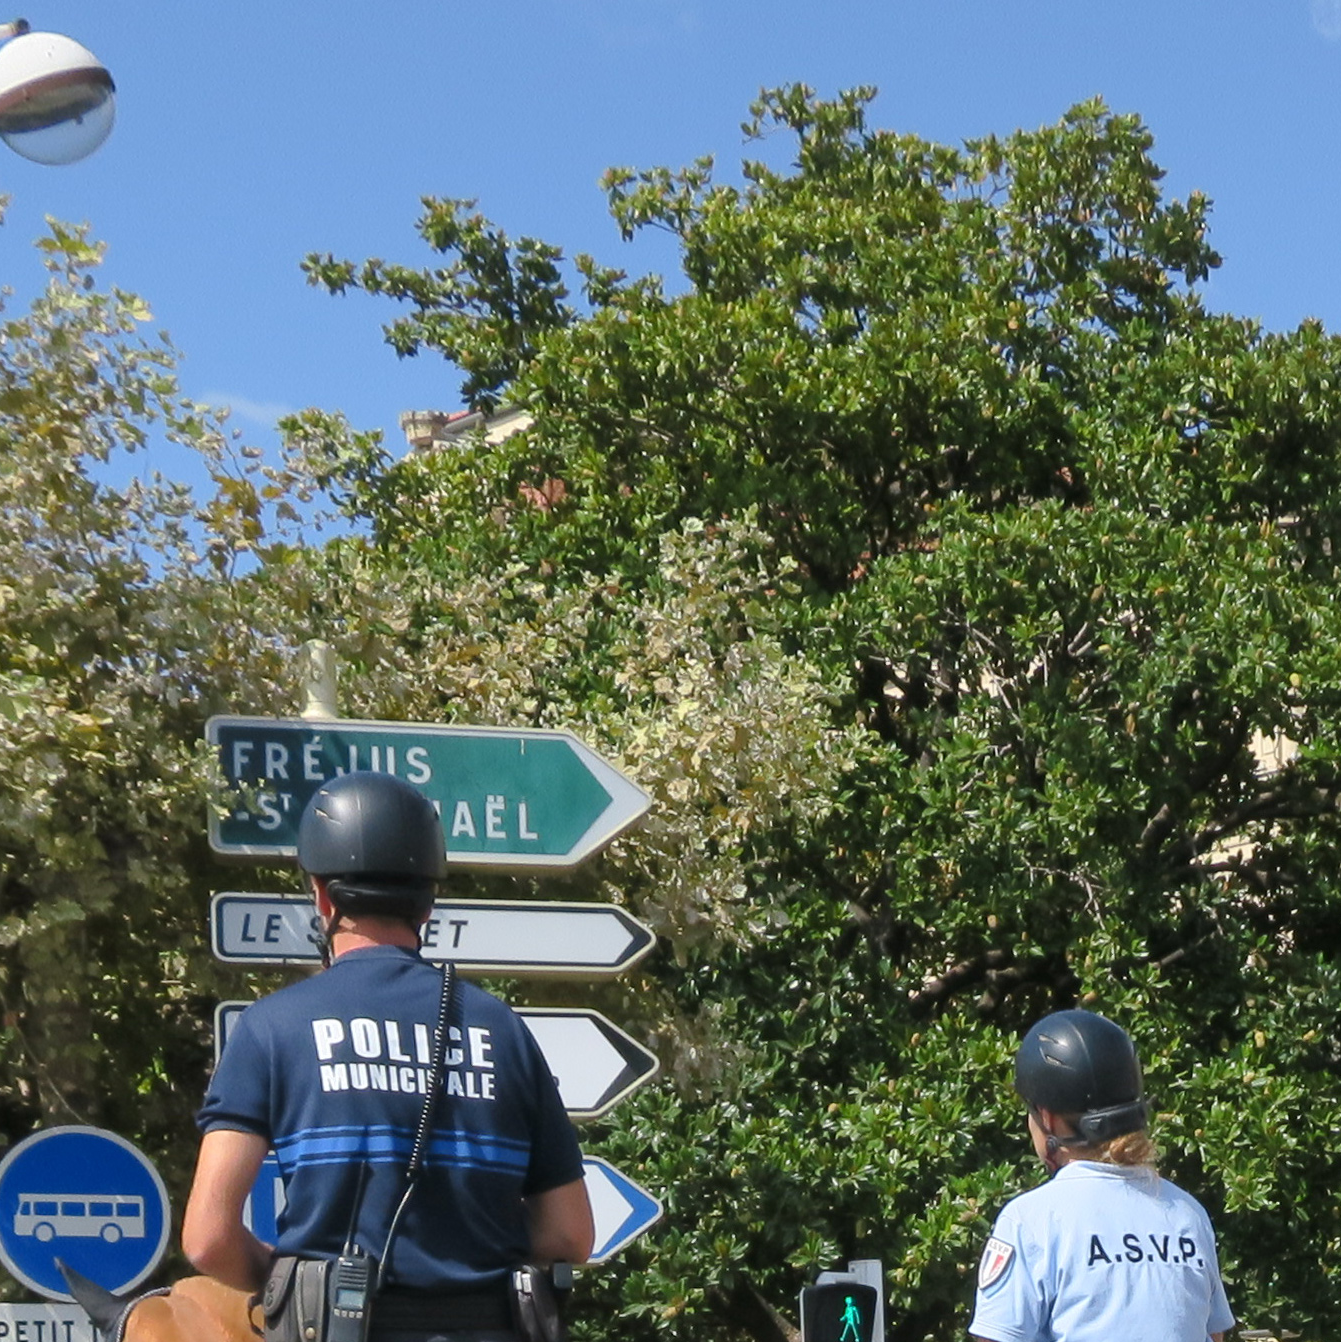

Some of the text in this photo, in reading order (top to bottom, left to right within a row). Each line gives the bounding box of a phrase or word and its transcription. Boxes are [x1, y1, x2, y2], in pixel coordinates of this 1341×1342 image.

[233, 736, 432, 784] FRÉJUS
[241, 913, 282, 943] LE
[311, 1018, 494, 1069] POLICE
[320, 1062, 496, 1100] MUNICIALE
[1088, 1234, 1203, 1267] A.S.V.P.
